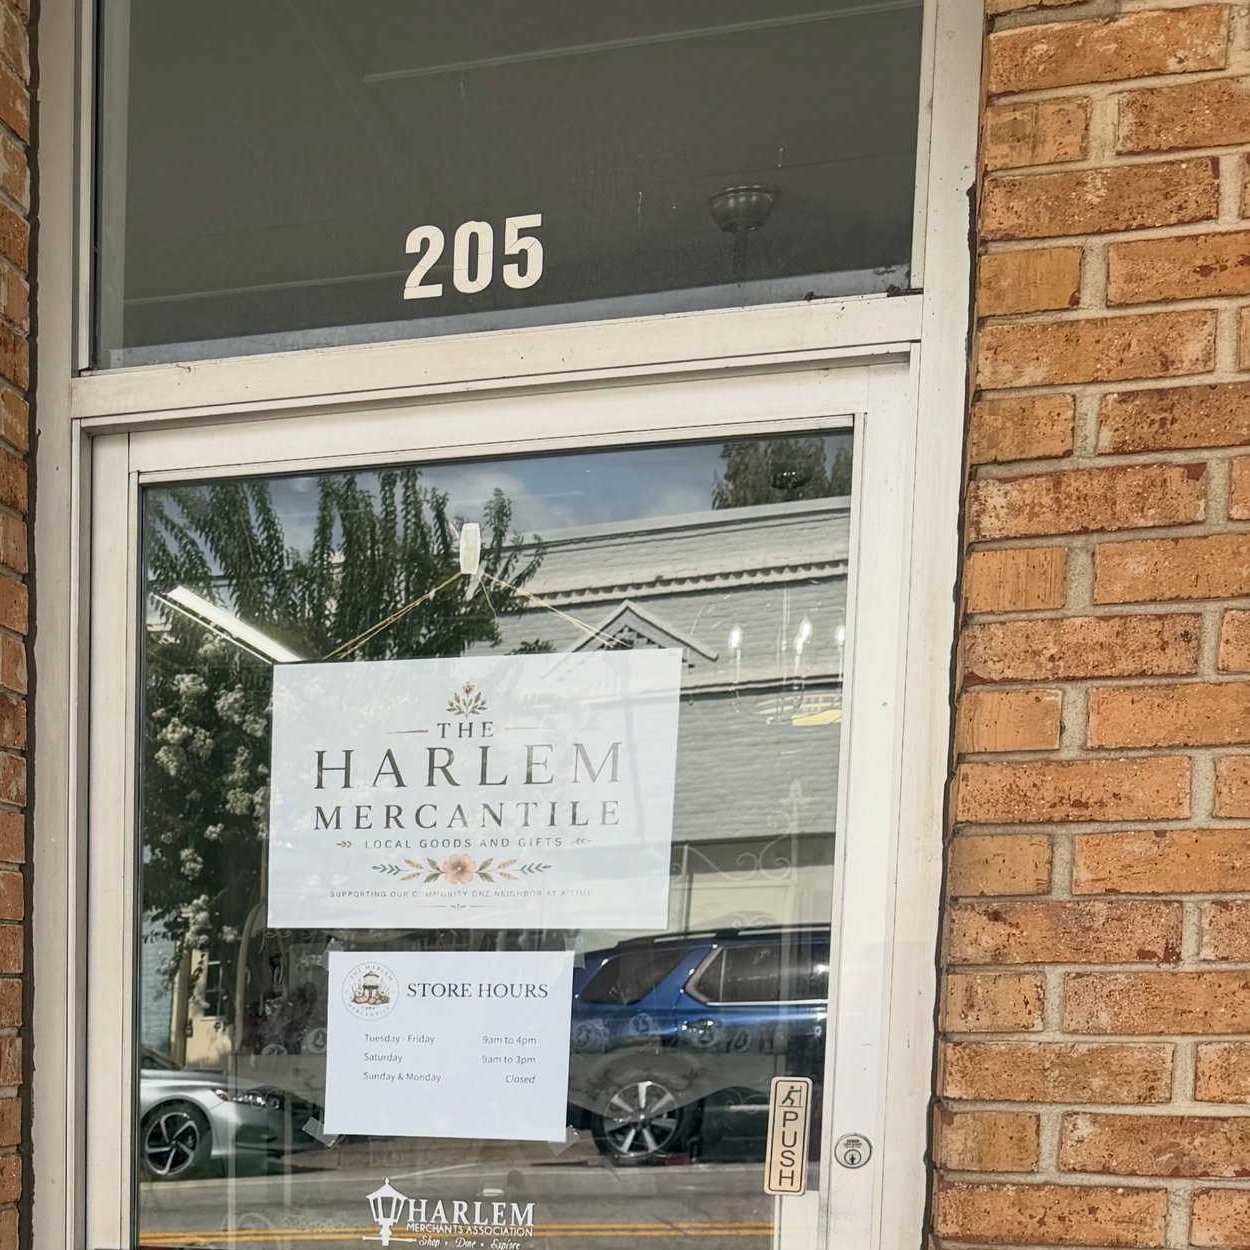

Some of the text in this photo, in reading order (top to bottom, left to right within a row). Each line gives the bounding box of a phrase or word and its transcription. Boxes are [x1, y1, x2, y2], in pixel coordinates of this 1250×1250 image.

[403, 213, 544, 300] 205
[437, 721, 495, 739] THE
[314, 741, 623, 790] HARLEM
[314, 800, 621, 831] MERCANTILE
[364, 837, 563, 850] LOCAL GOODS AND GIFTS
[330, 890, 387, 898] SUPPORTING
[390, 890, 409, 898] OUR
[406, 982, 549, 999] STORE HOURS
[364, 1033, 401, 1045] Tuesday
[407, 1034, 435, 1046] Friday
[482, 1036, 537, 1047] 9am to 4pm
[364, 1052, 403, 1064] Saturday
[481, 1055, 536, 1066] 9am to 3pm
[363, 1071, 441, 1084] Sunday & Monday
[505, 1074, 536, 1085] Closed
[778, 1110, 800, 1187] PUSH
[406, 1199, 536, 1227] HARLEM
[406, 1222, 533, 1238] MERCHANTS ASSOCIATION
[418, 1236, 521, 1250] Shop Dine Explore
